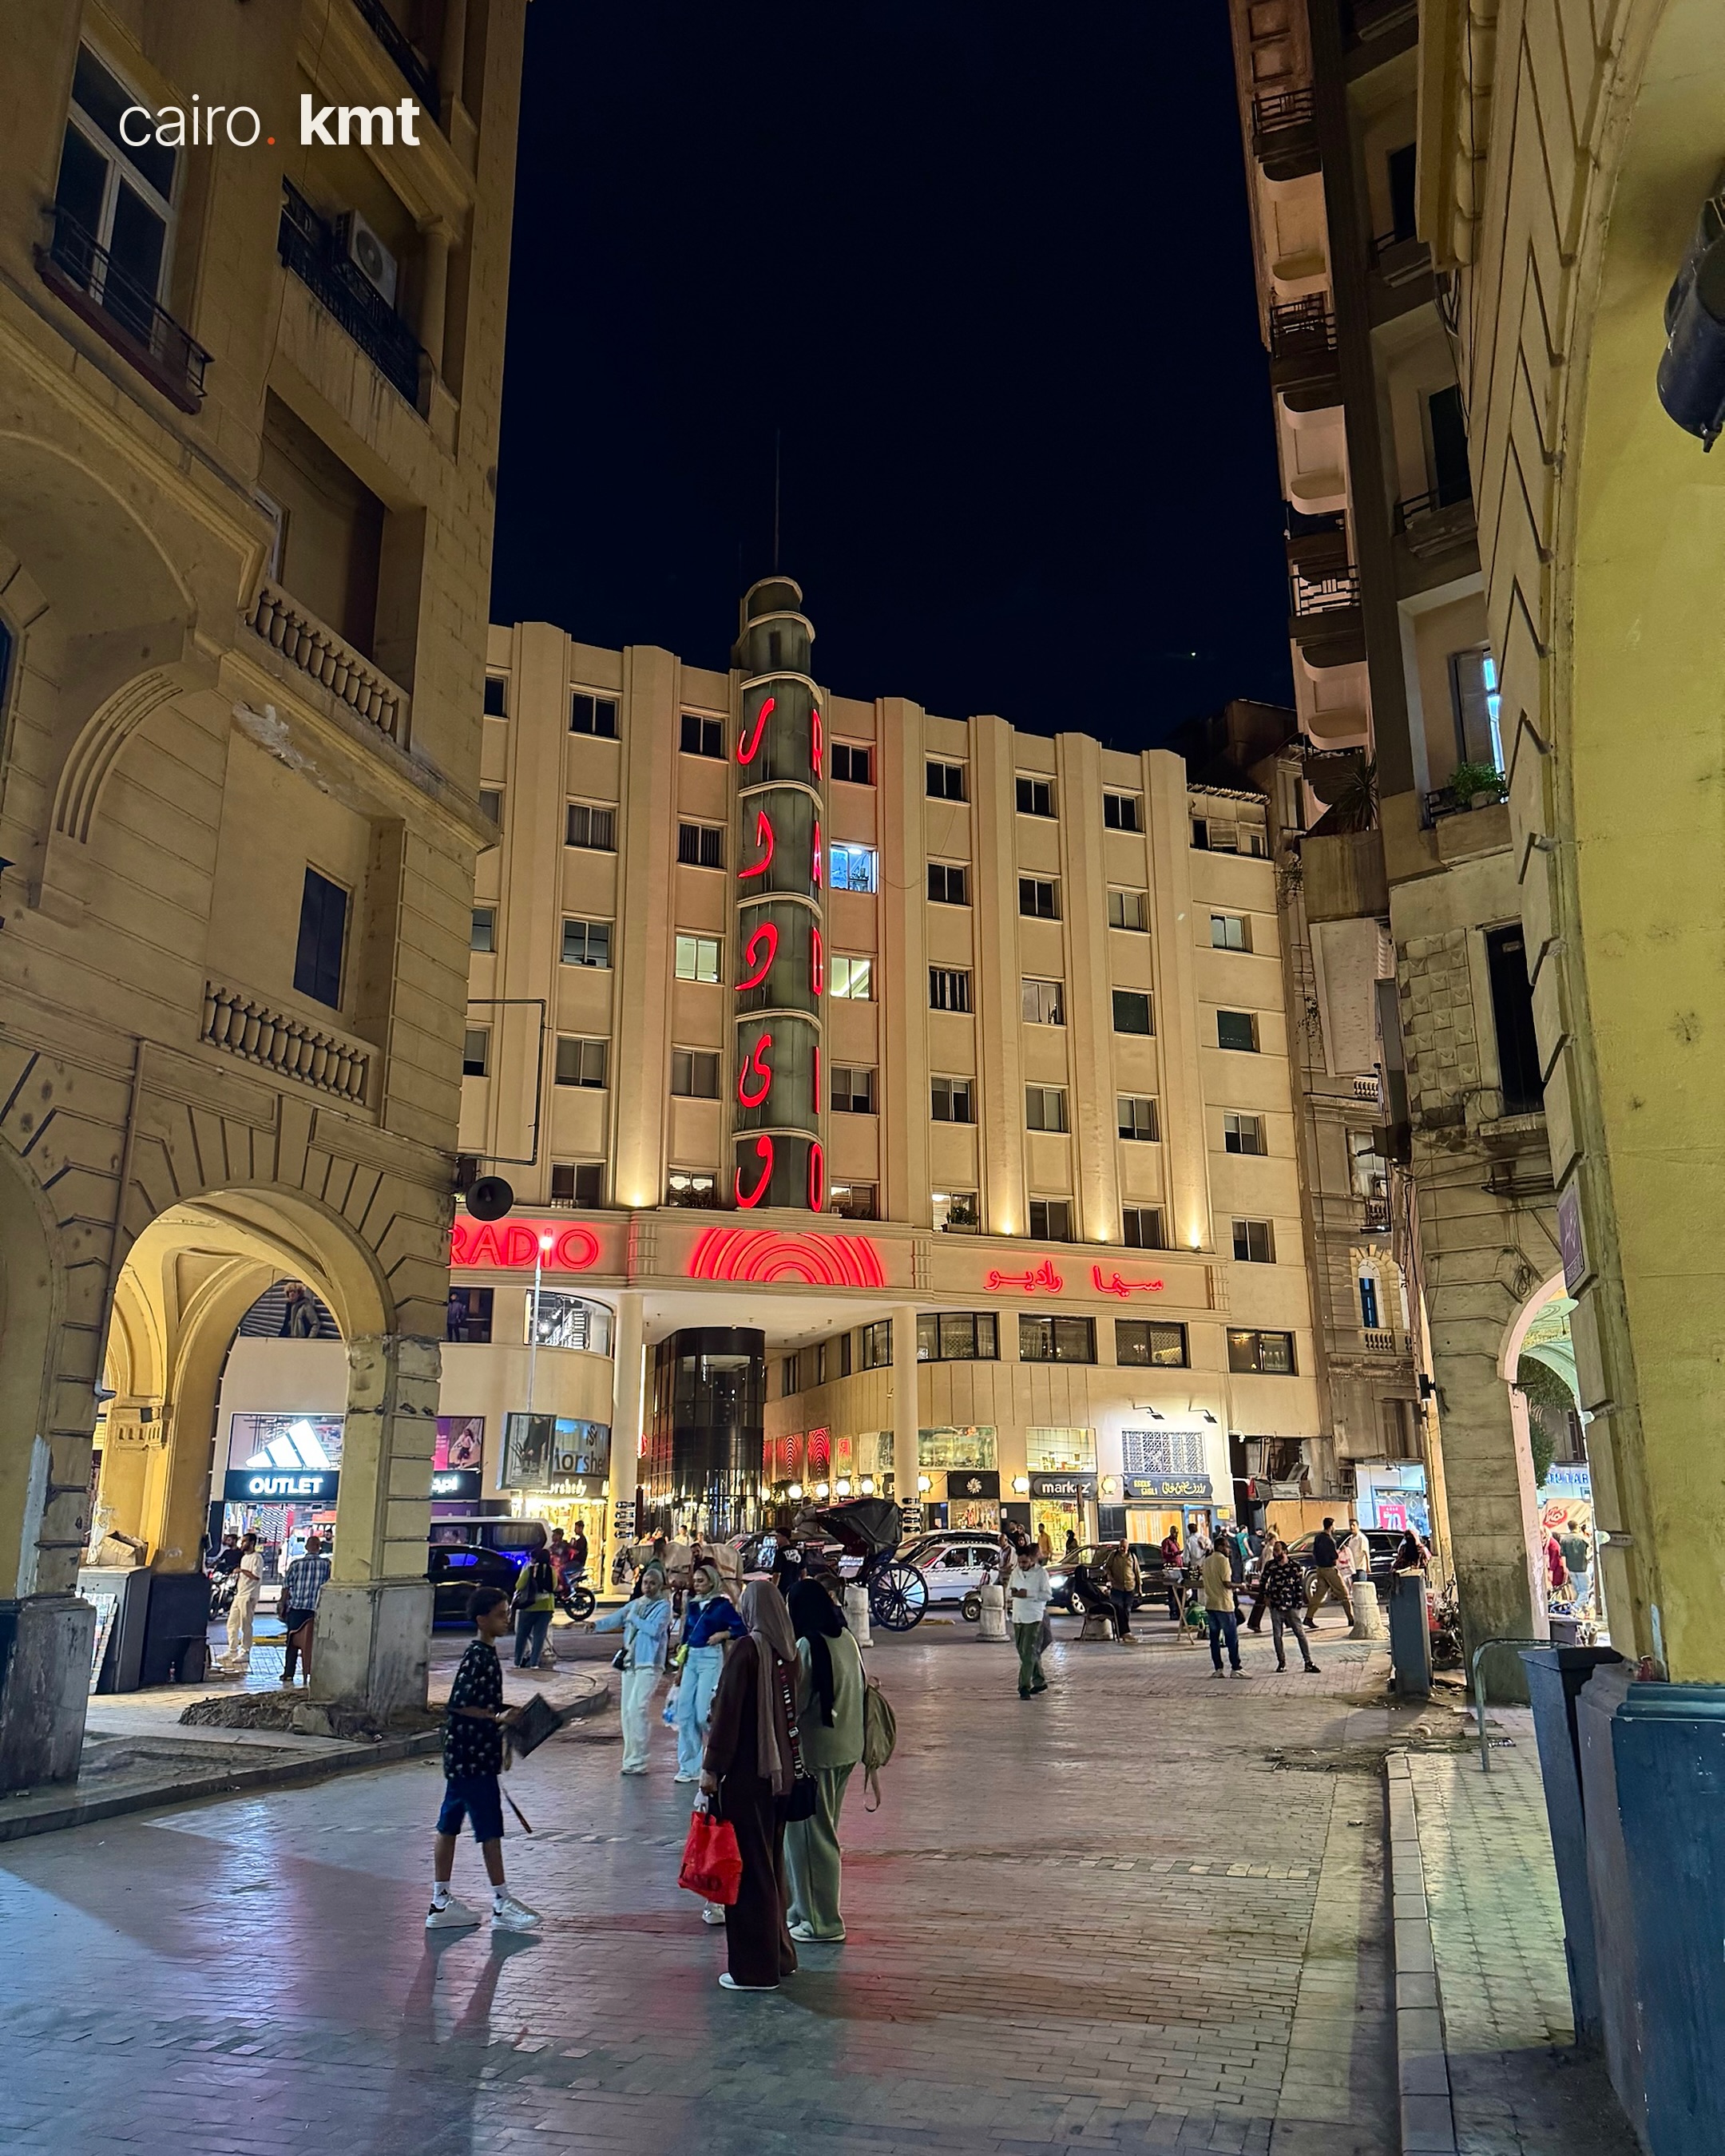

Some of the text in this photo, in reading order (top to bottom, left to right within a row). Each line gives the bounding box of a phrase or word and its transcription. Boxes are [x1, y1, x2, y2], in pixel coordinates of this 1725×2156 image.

[807, 708, 824, 1213] RADIO
[451, 1224, 599, 1270] RADIO
[983, 1260, 1164, 1298] سينما راديو
[553, 1447, 605, 1472] orshe
[248, 1476, 324, 1495] OUTLET
[536, 1479, 587, 1497] orshedy
[1041, 1480, 1092, 1494] markz
